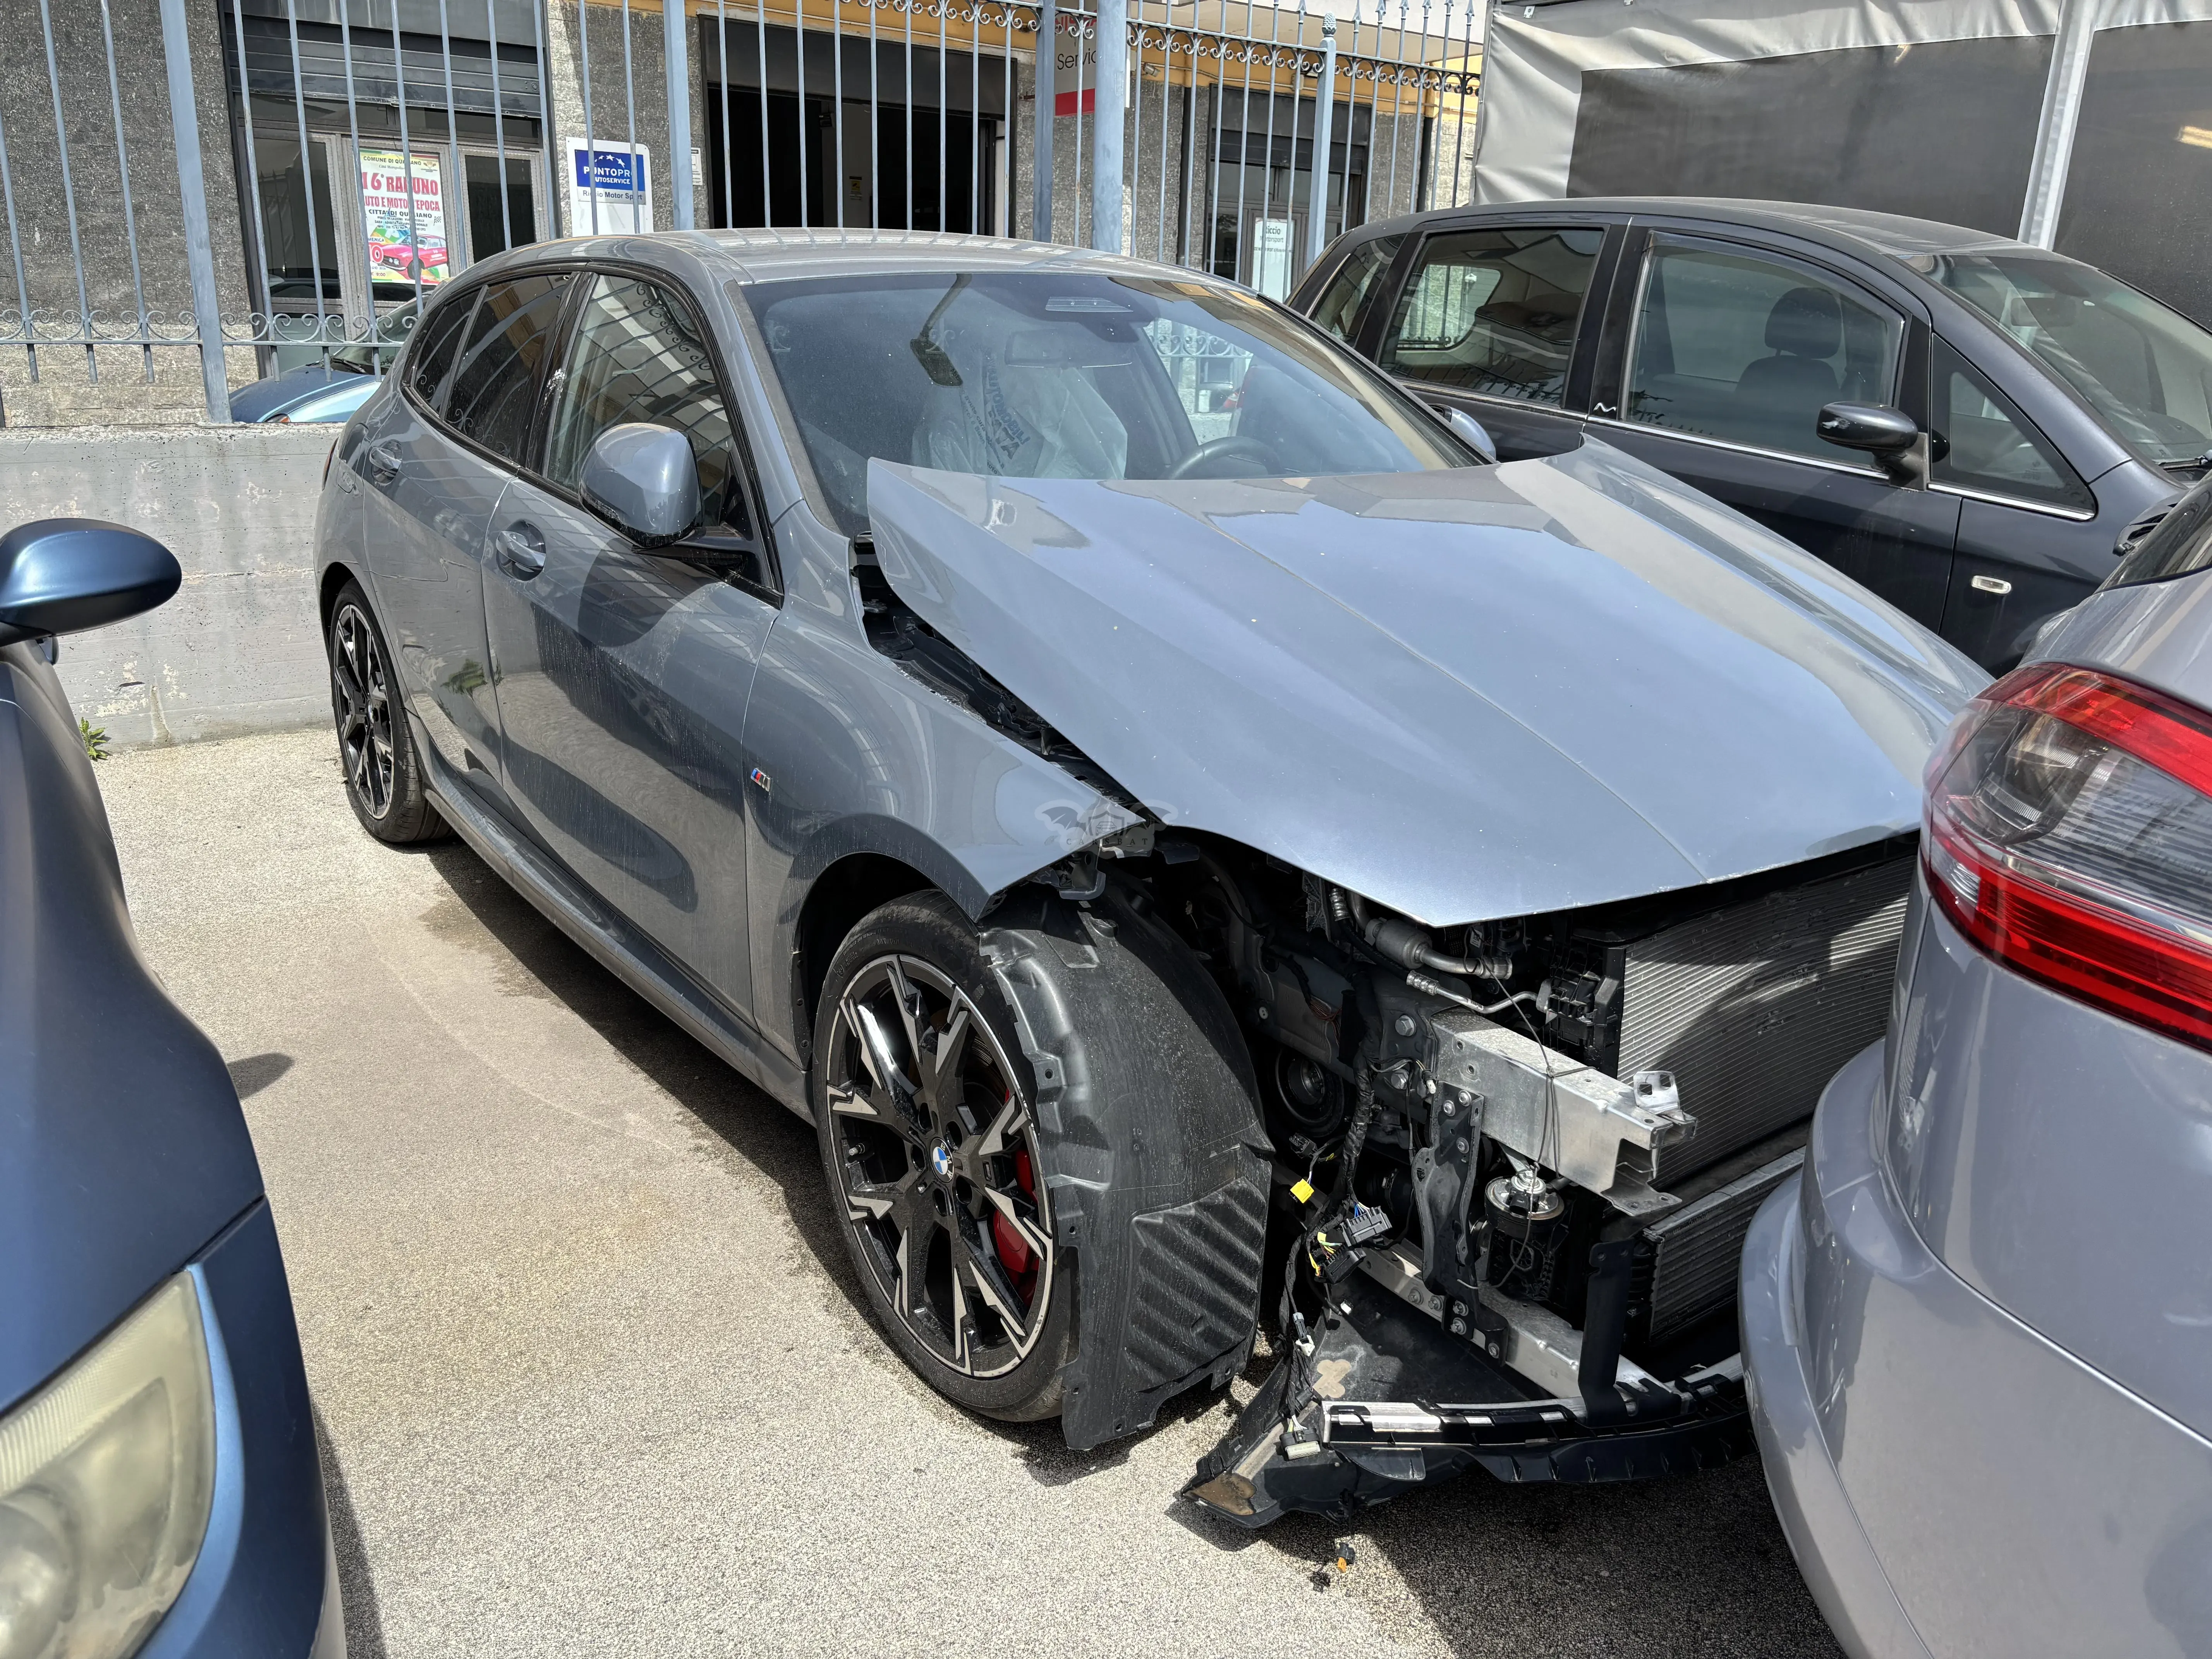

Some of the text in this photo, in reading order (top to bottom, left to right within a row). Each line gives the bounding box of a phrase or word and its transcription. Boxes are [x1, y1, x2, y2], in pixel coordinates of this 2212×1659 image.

[1057, 48, 1096, 70] Servic
[365, 196, 380, 207] UTO
[381, 197, 386, 208] E
[386, 197, 409, 209] MOTO
[1266, 226, 1281, 235] iccio
[940, 1142, 953, 1179] BMW
